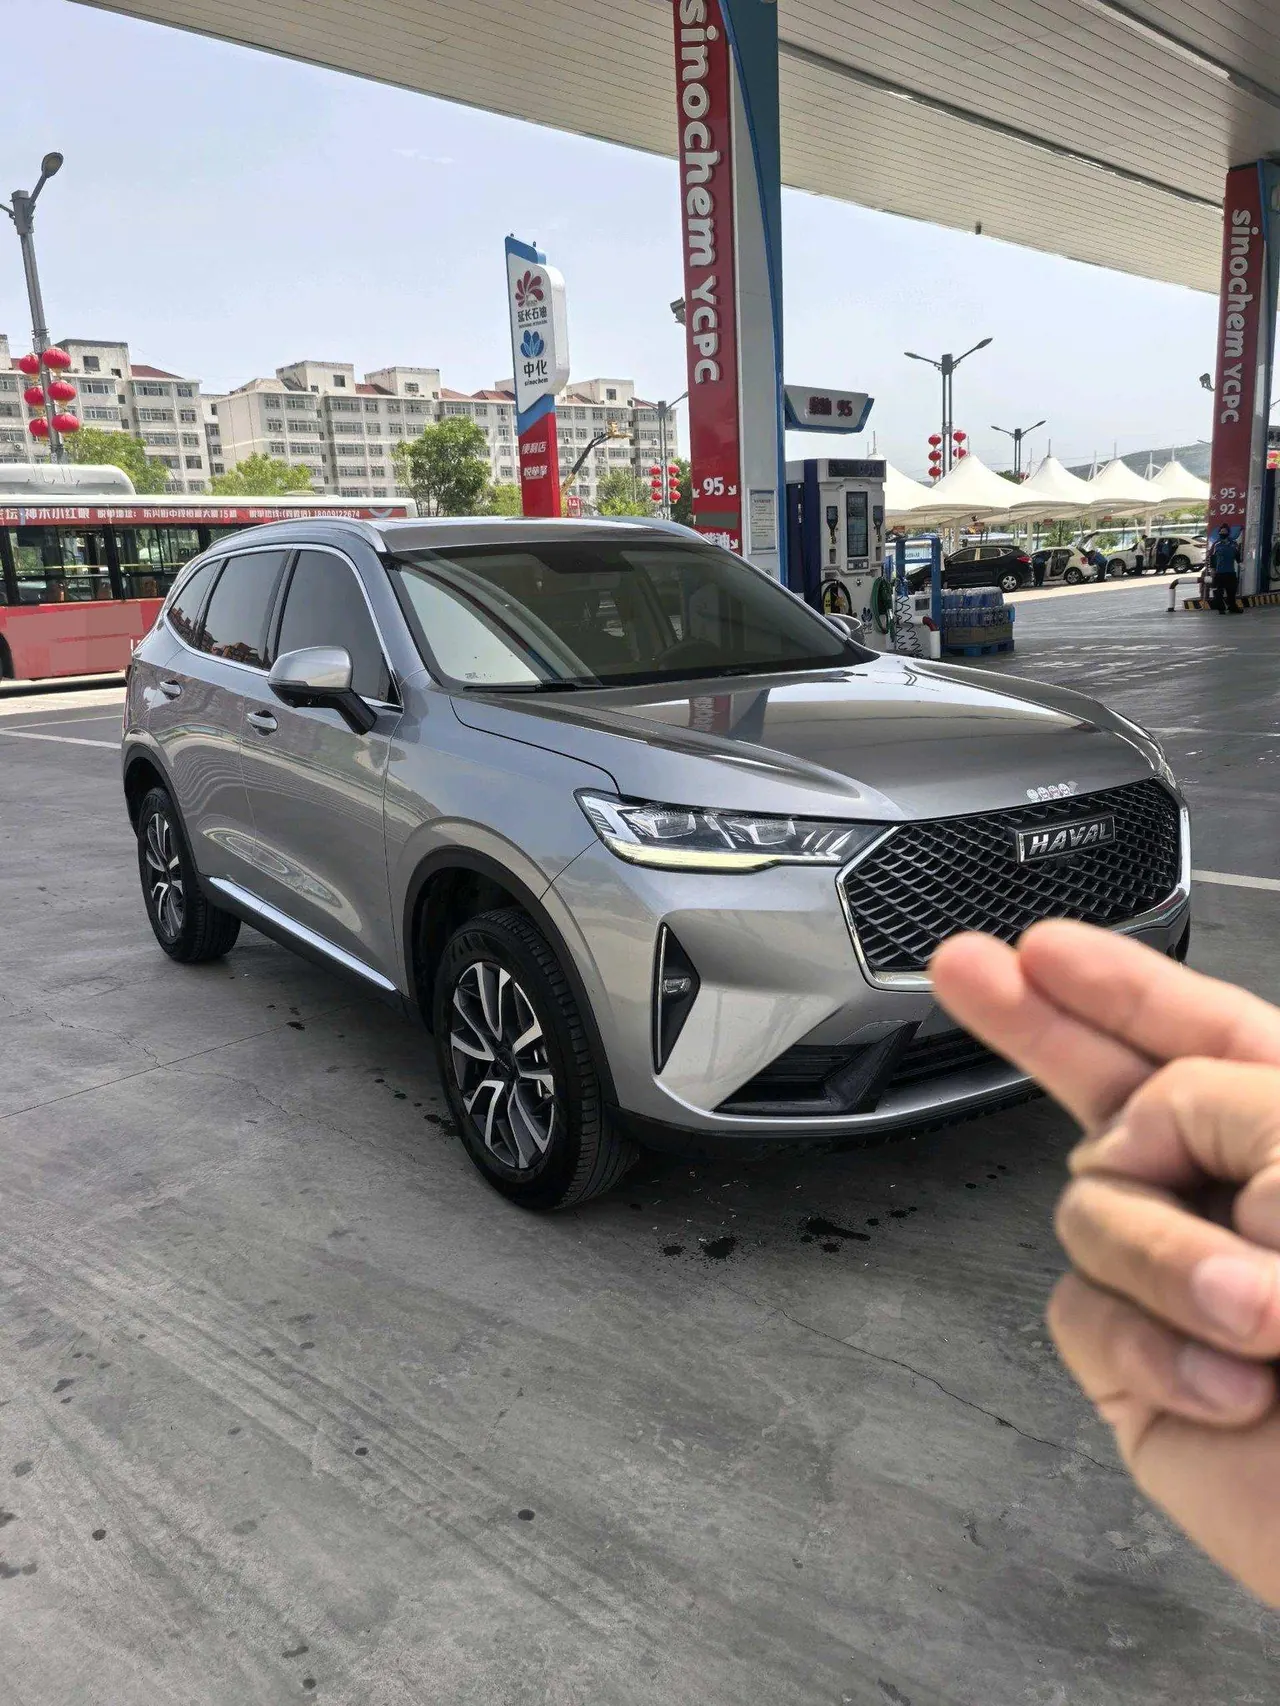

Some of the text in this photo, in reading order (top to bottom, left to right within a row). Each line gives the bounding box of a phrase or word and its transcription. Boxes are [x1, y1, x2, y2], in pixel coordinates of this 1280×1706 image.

[679, 0, 719, 384] sinochem YCPC
[517, 306, 547, 323] 延长石油
[1220, 209, 1259, 424] sinochem YCPC
[523, 360, 548, 378] 中化
[524, 378, 548, 387] sinochem
[836, 399, 853, 417] 95
[703, 476, 724, 496] 95
[1220, 487, 1236, 499] 95
[1220, 503, 1235, 515] 92
[1029, 823, 1112, 855] HAVAL
